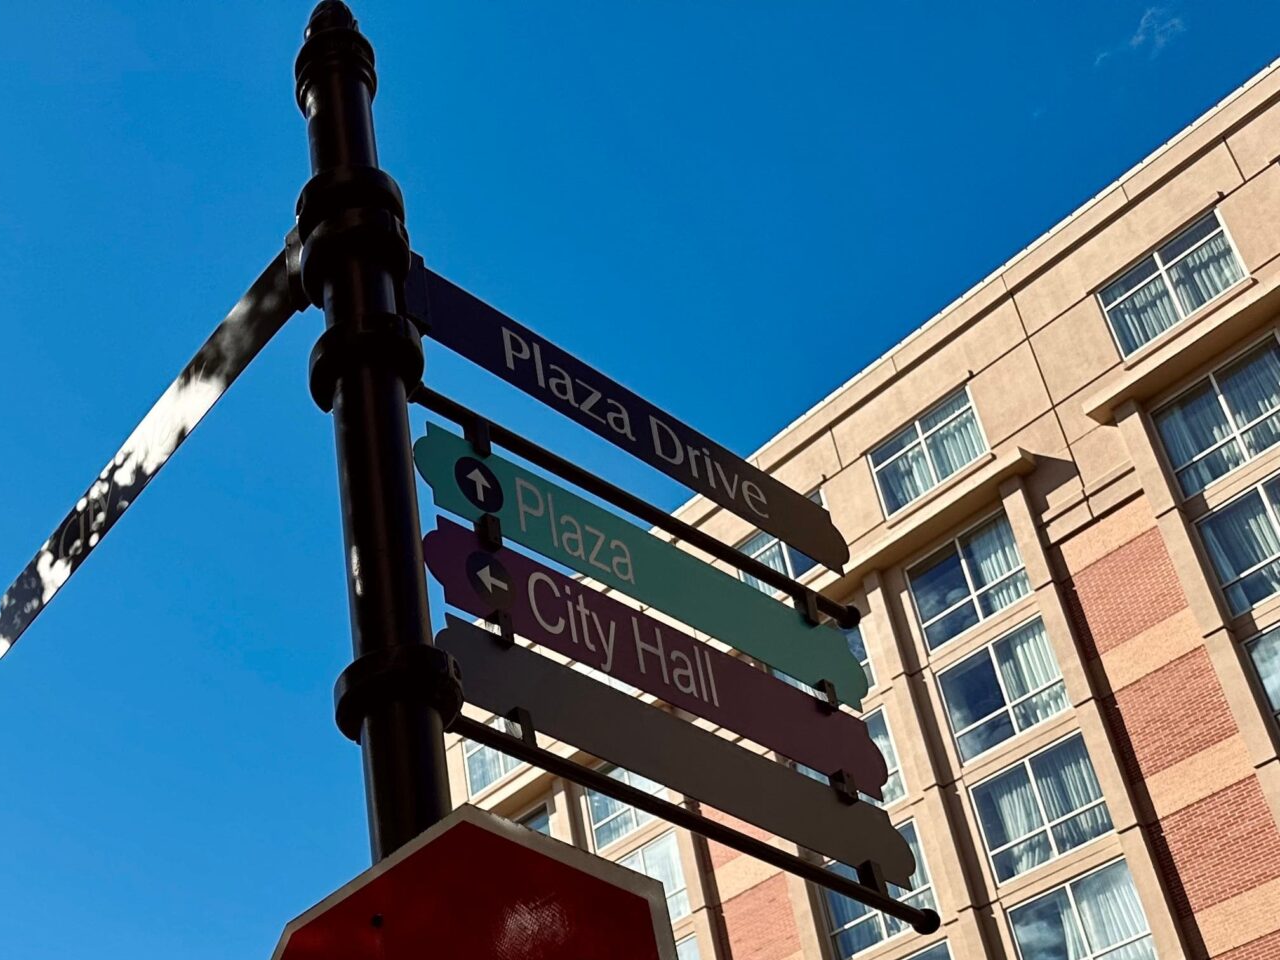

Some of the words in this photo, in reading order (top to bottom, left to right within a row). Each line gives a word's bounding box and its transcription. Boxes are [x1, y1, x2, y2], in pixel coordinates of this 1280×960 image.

[501, 326, 636, 442] Plaza
[648, 415, 769, 519] Drive
[515, 477, 635, 584] Plaza
[527, 571, 616, 672] City
[631, 616, 720, 707] Hall
